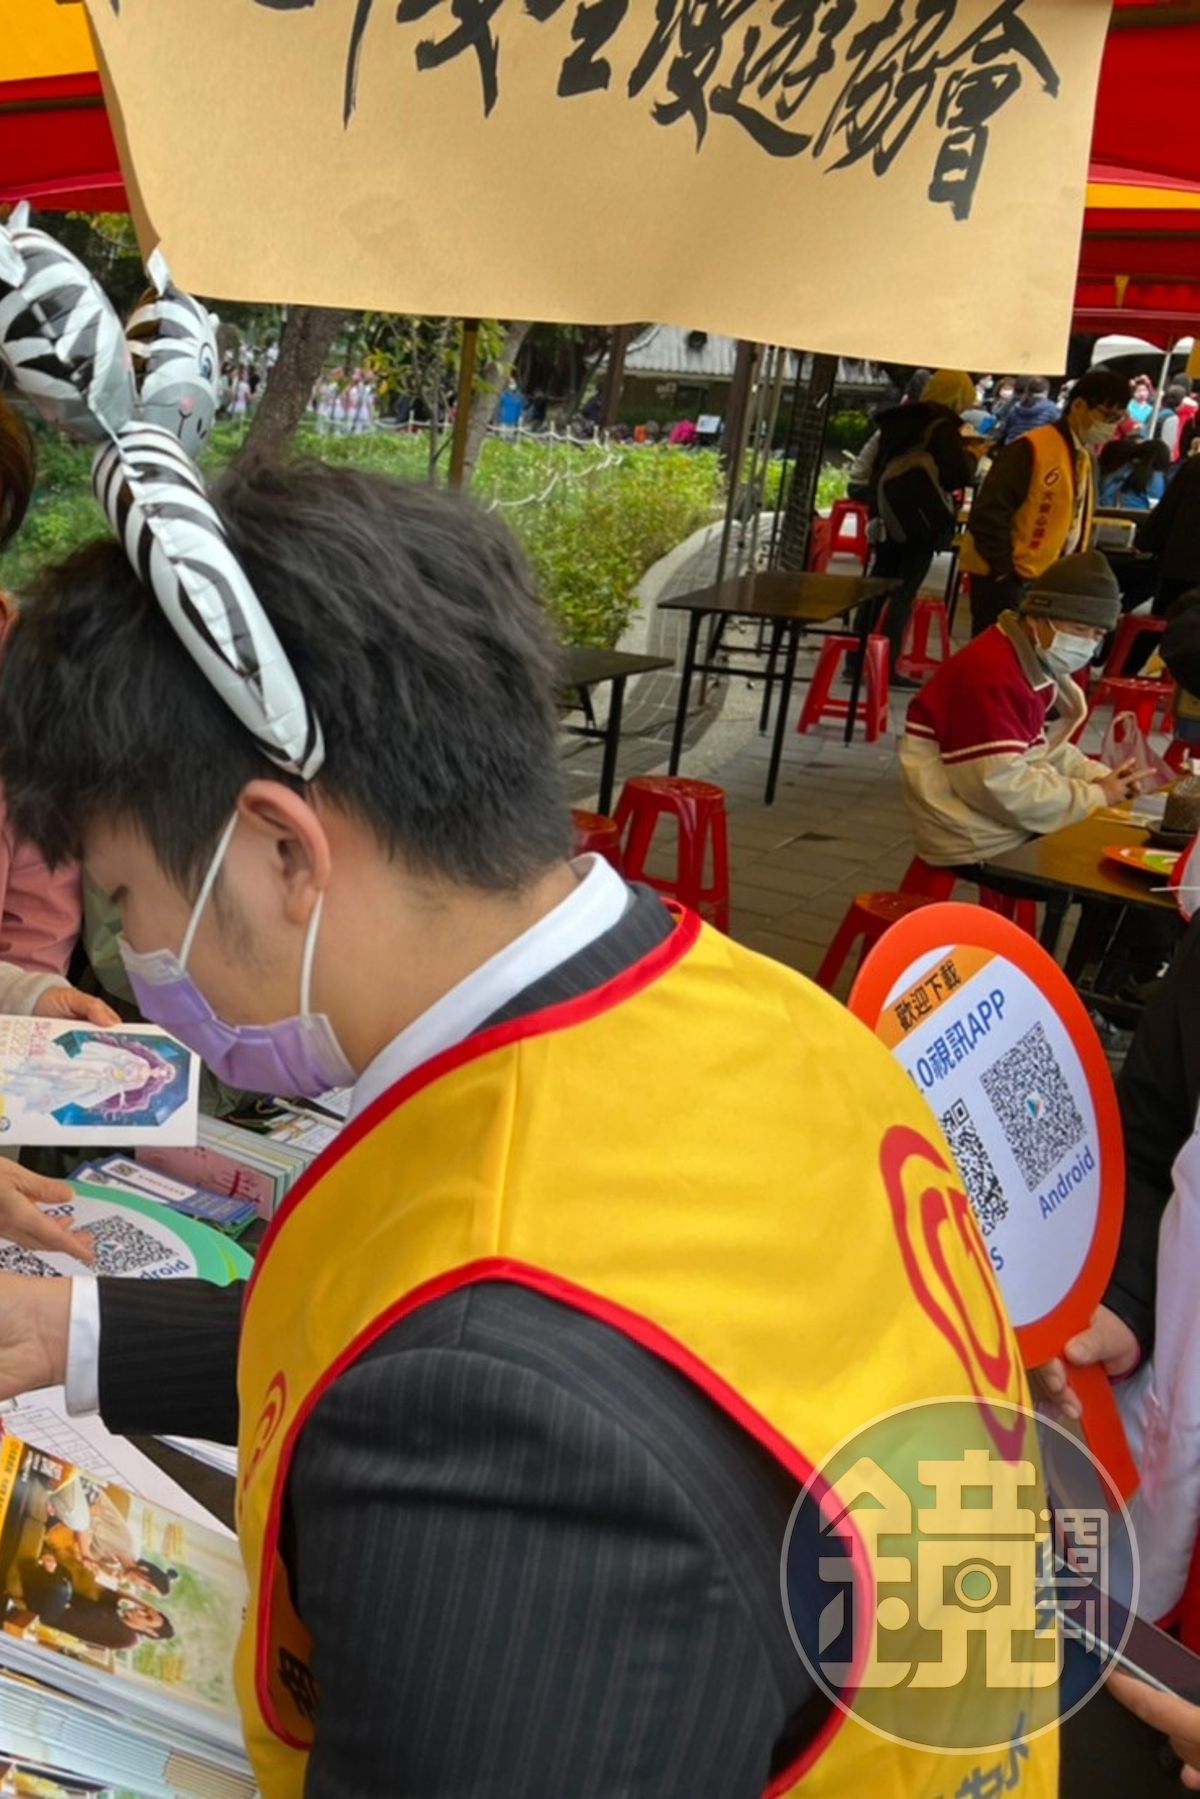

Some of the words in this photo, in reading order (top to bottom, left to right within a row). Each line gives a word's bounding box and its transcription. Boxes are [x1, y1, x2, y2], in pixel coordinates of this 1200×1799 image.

[895, 961, 962, 1032] 歡迎下載
[1038, 1145, 1096, 1220] Android
